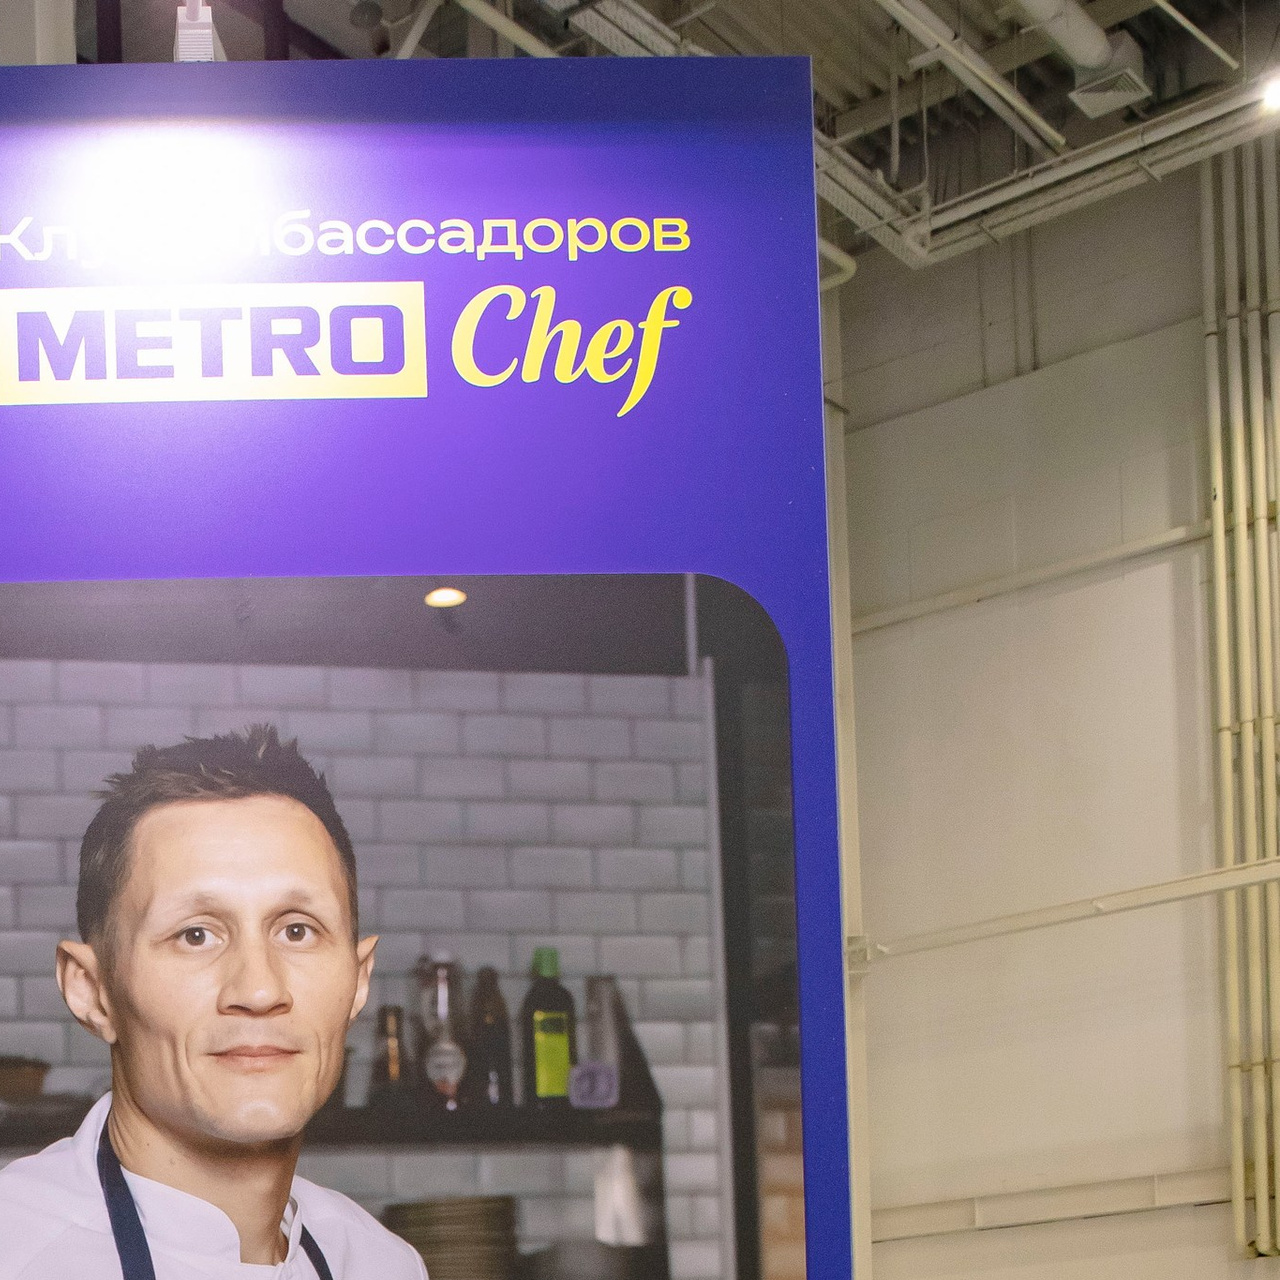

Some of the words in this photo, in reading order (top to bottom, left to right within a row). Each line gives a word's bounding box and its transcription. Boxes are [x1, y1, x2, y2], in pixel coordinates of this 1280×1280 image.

[250, 209, 690, 261] бассадоров
[16, 304, 405, 382] METRO
[451, 282, 694, 417] Chef
